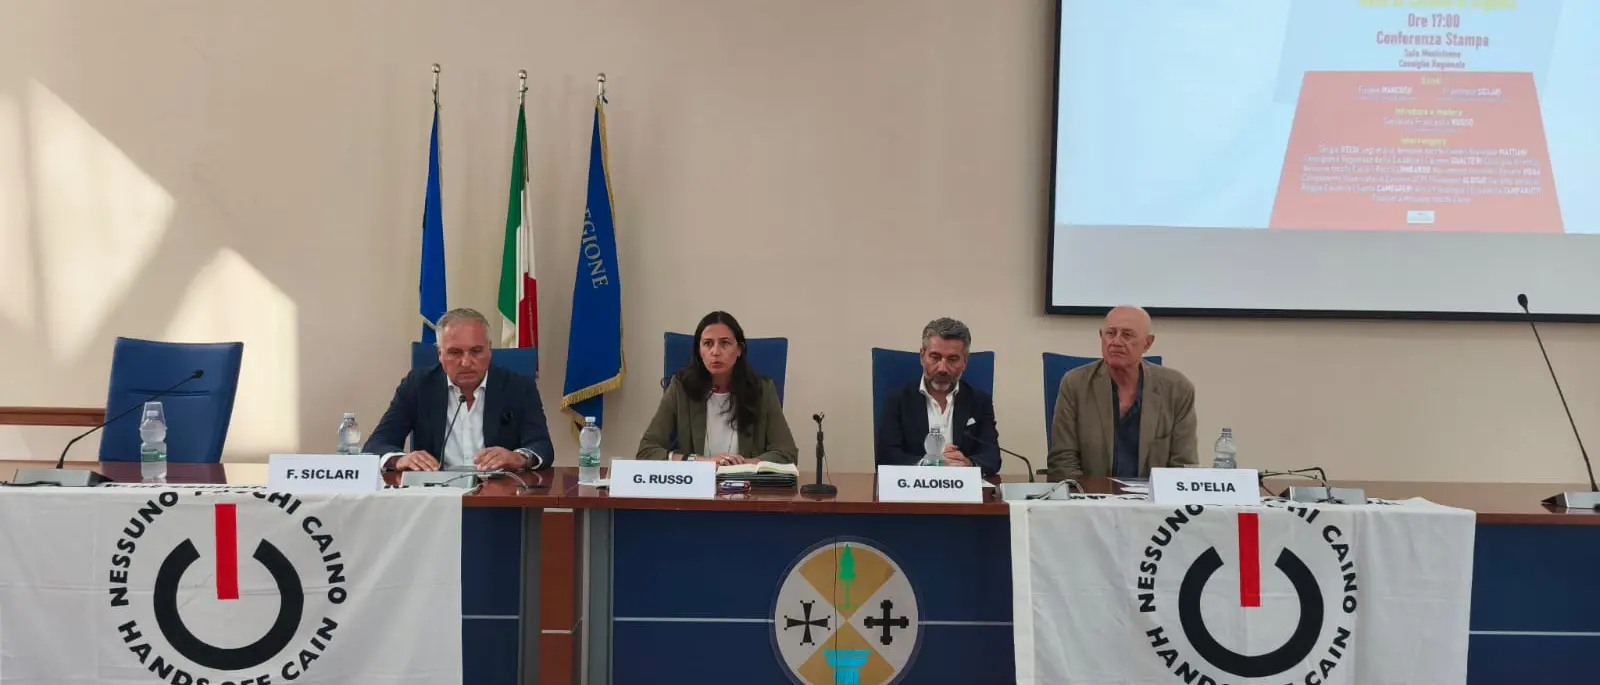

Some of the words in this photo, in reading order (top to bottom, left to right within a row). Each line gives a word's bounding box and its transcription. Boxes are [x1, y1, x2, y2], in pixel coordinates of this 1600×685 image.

[1376, 31, 1442, 45] Conferenza
[1445, 32, 1489, 49] Stampa
[1407, 13, 1428, 27] Ore
[1432, 13, 1460, 28] 17:00
[286, 469, 299, 480] F.
[301, 469, 360, 480] SICLARI
[633, 474, 646, 485] G.
[648, 474, 694, 485] RUSSO
[897, 478, 910, 489] G.
[913, 478, 964, 490] ALOISIO
[1176, 481, 1188, 492] S.
[1190, 481, 1237, 493] D'ELIA
[109, 491, 180, 608] NESSUNO
[302, 515, 348, 606] CAINO
[1137, 504, 1205, 614] NESSUNO
[1322, 524, 1359, 615] CAINO
[281, 616, 339, 682] CAIN
[1145, 626, 1230, 685] HAND
[1304, 626, 1352, 685] CAIN
